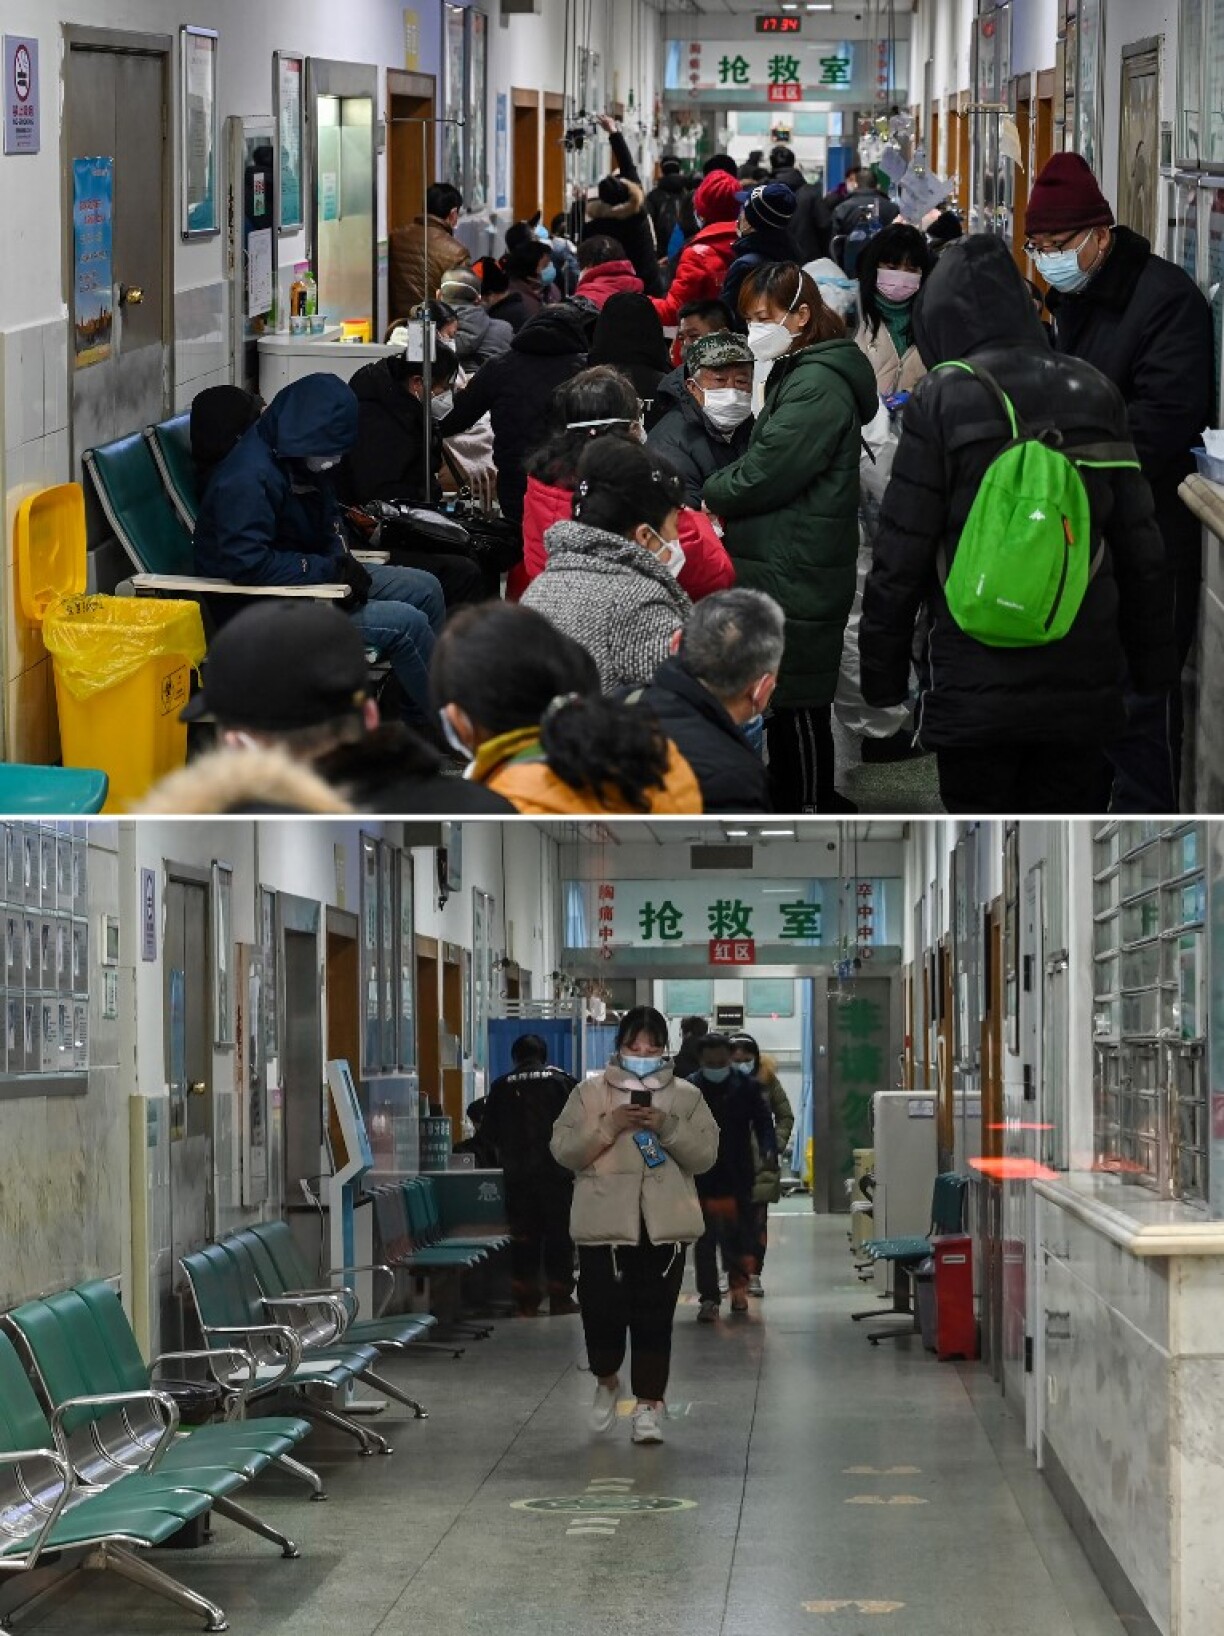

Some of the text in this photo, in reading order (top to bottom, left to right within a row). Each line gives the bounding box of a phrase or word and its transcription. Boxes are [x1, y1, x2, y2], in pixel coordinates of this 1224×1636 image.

[718, 54, 852, 84] 抢救室
[771, 87, 799, 100] 红区
[598, 883, 614, 960] 胸痛中心
[638, 899, 822, 940] 抢救室
[856, 882, 873, 960] 卒中中心
[714, 943, 751, 962] 红区
